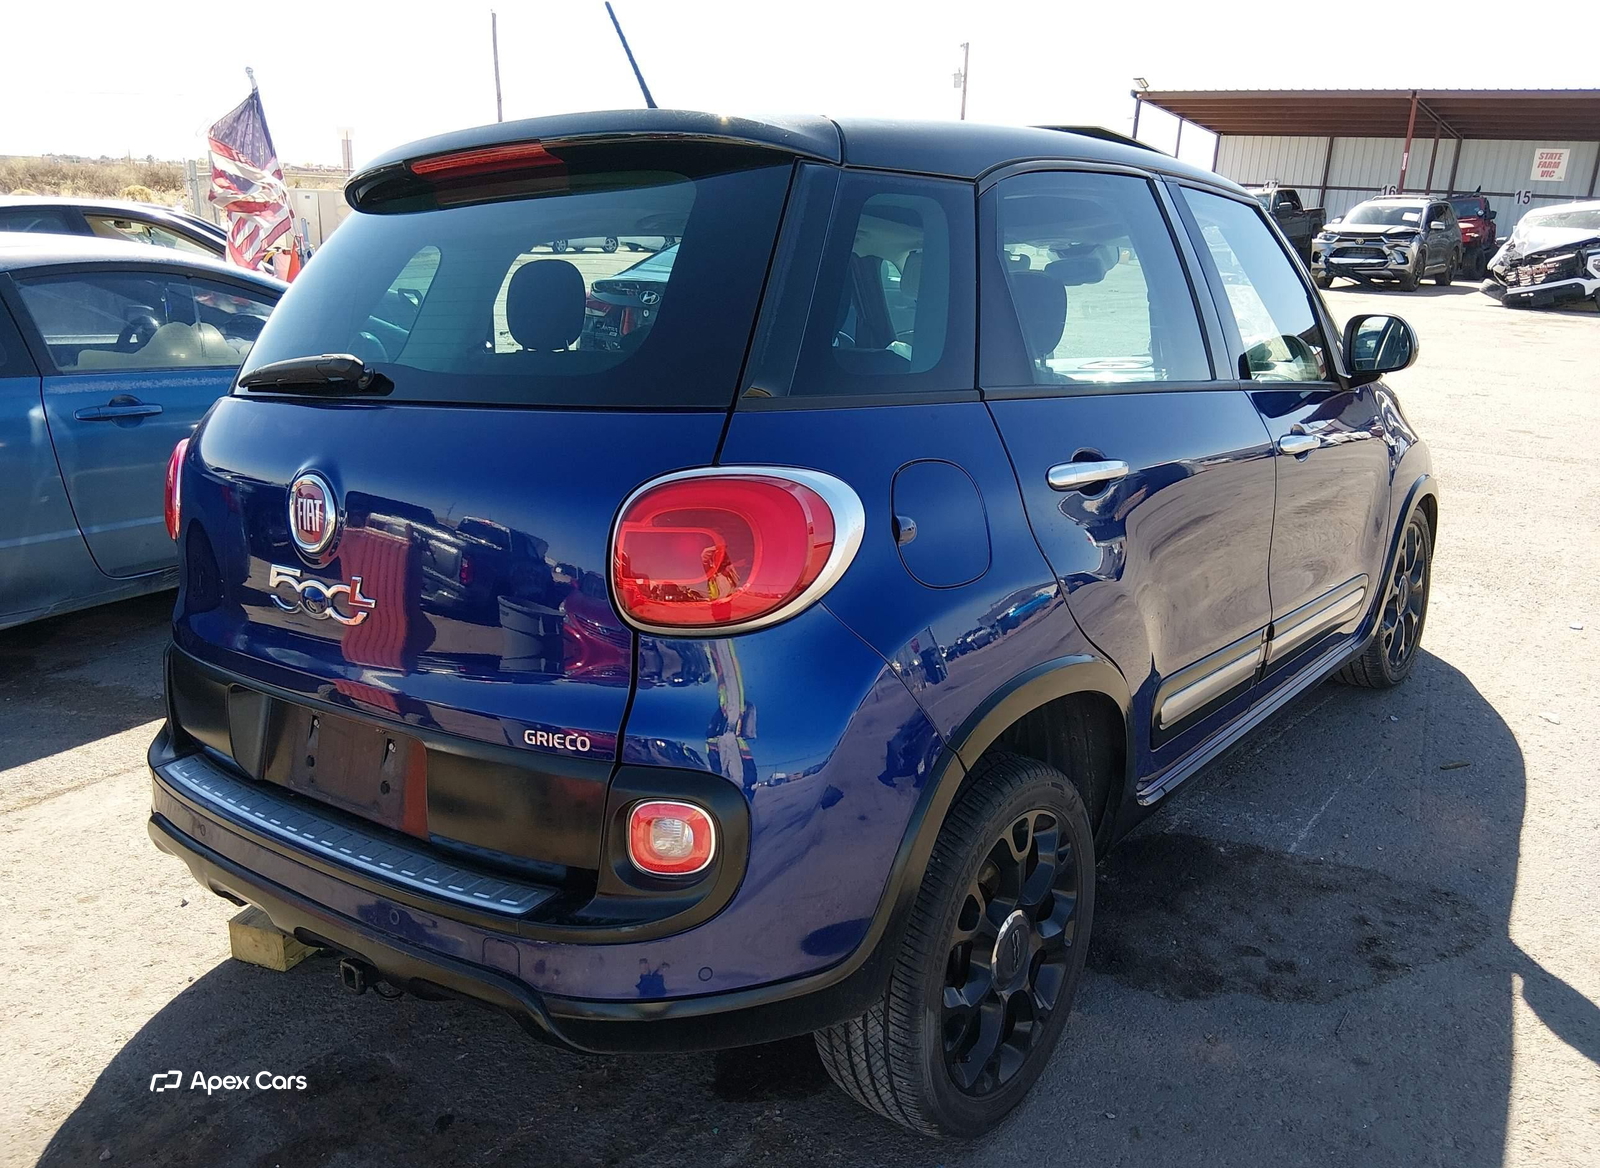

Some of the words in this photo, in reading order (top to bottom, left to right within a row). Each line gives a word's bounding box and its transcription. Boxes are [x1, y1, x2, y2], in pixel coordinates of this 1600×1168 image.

[1538, 152, 1564, 160] STATE
[1537, 161, 1561, 169] FARM
[1540, 170, 1556, 178] VIC
[1382, 185, 1396, 195] 16
[1515, 190, 1531, 205] 15
[297, 498, 323, 532] FIAT
[269, 564, 376, 626] 500L
[524, 730, 590, 752] GRIECO
